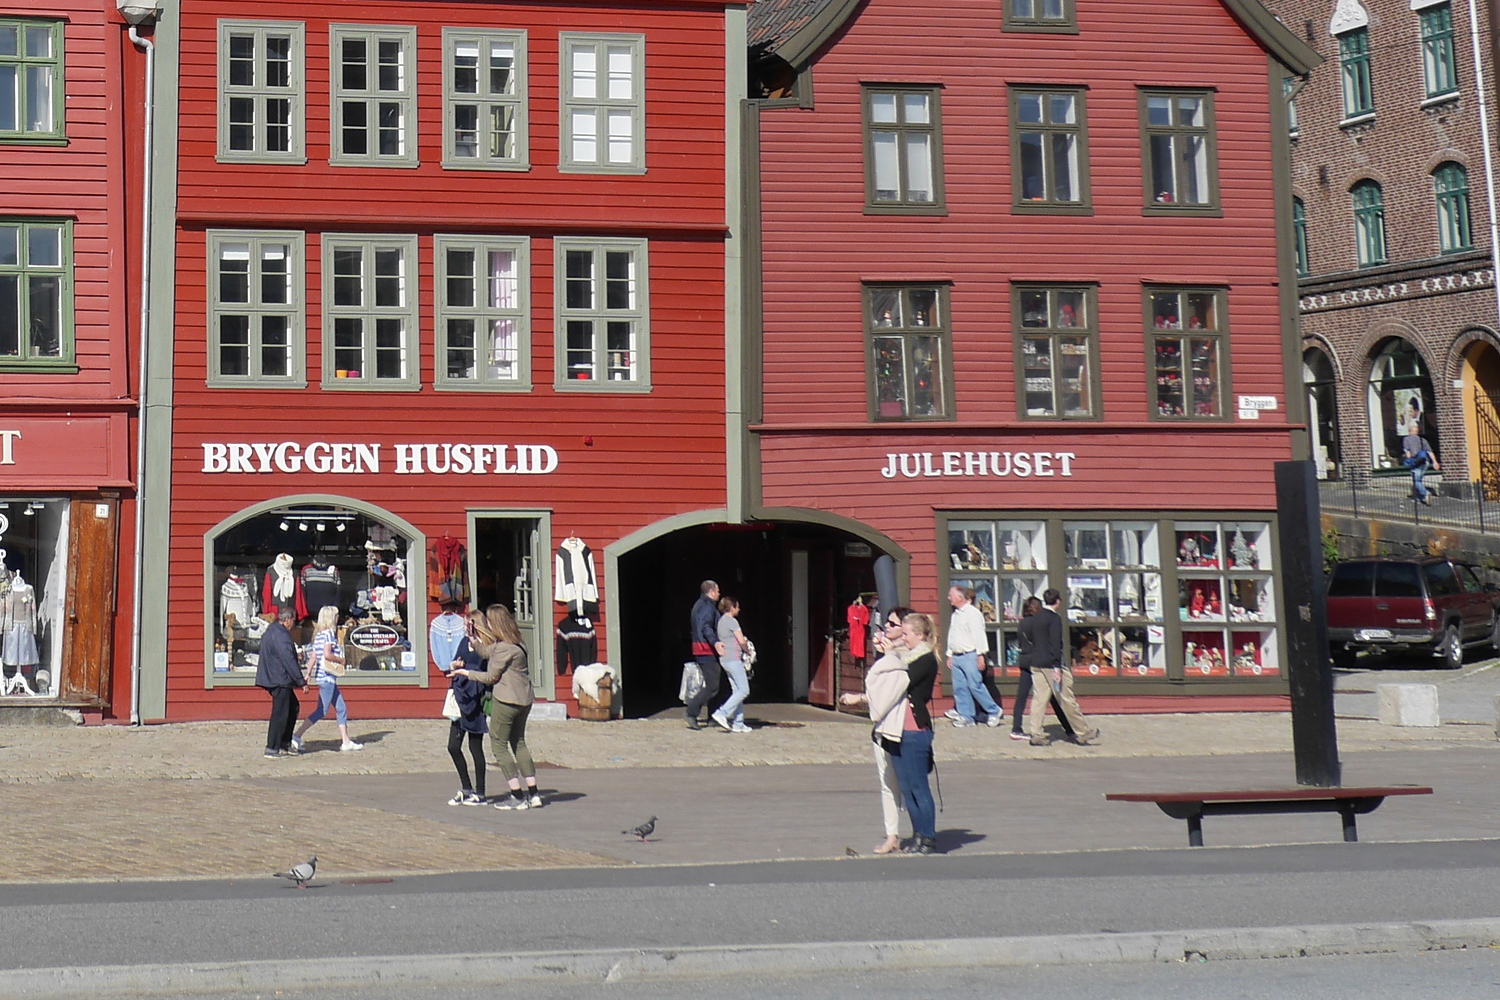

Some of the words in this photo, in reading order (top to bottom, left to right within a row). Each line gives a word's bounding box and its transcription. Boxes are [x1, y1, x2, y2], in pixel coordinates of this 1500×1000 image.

[1244, 397, 1273, 409] Bryggen
[201, 441, 381, 474] BRYGGEN
[394, 443, 559, 474] HUSFLID
[881, 451, 1076, 478] JULEHUSET
